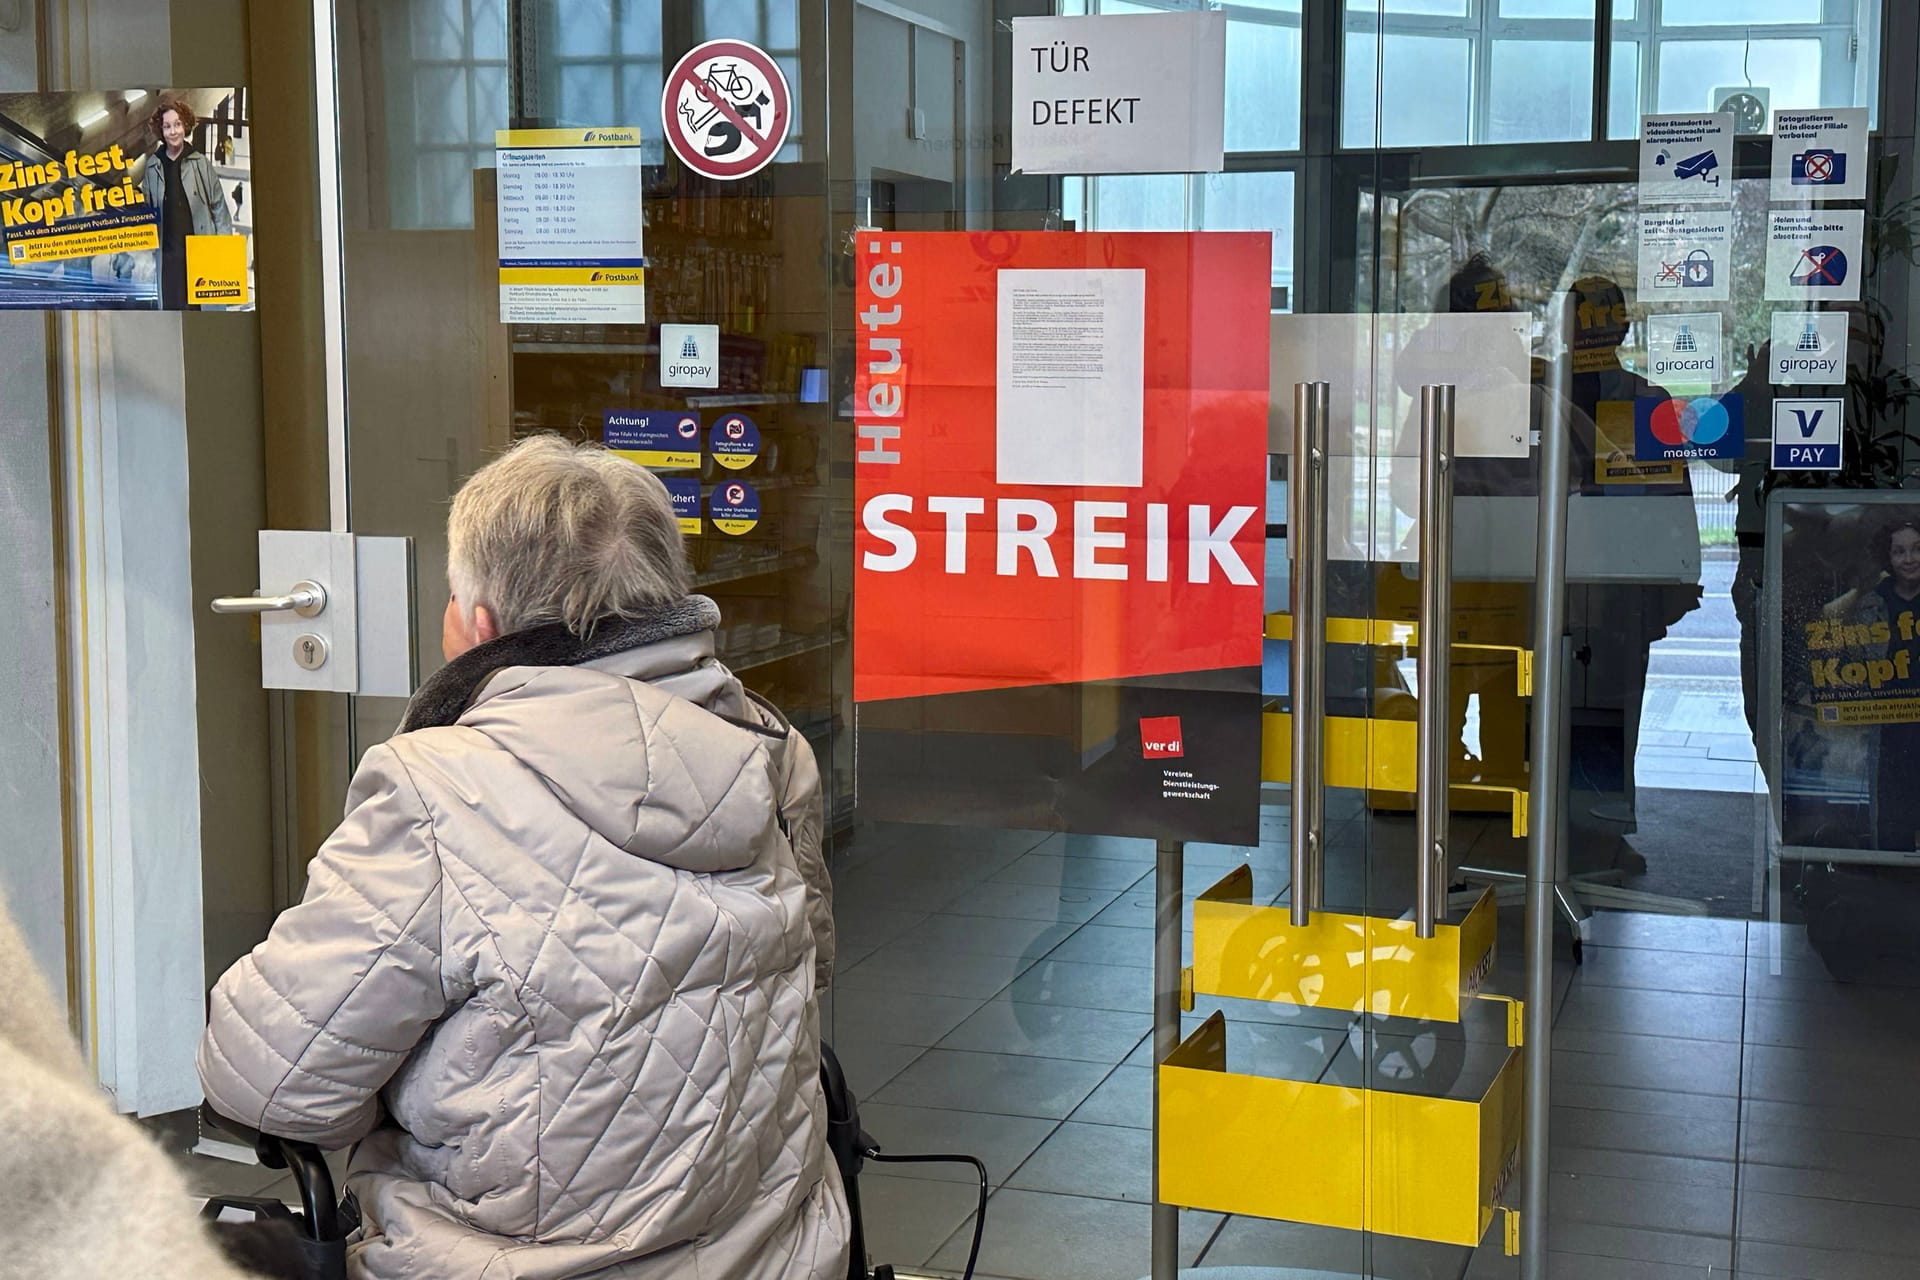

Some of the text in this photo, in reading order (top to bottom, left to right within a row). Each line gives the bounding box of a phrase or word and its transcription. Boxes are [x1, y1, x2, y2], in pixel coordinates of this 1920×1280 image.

[1031, 41, 1090, 73] TÜR
[1033, 98, 1141, 125] DEFEKT
[1646, 120, 1669, 128] Dieser
[1670, 119, 1702, 127] Standort
[1778, 115, 1834, 124] Fotografieren
[1646, 127, 1705, 136] videoüberwacht
[1778, 123, 1789, 131] ist
[1799, 122, 1823, 130] dieser
[1824, 122, 1848, 130] Filiale
[598, 133, 634, 142] Postbank
[1646, 135, 1703, 145] alarmgesichert!
[1778, 131, 1817, 140] verboten!
[0, 144, 135, 192] Zins fest.
[2, 177, 145, 227] Kopf frei.
[1644, 217, 1685, 228] Bargeld ist
[1773, 216, 1812, 224] Helm und
[1773, 224, 1844, 232] Sturmhaube bitte
[1773, 232, 1812, 240] absetzen!
[605, 272, 639, 282] Postbank
[858, 240, 903, 465] Heute:
[668, 362, 712, 378] giropay
[1655, 356, 1714, 374] girocard
[1779, 356, 1838, 374] giropay
[608, 416, 649, 428] Achtung!
[1788, 409, 1824, 438] V
[1663, 447, 1717, 458] maestro
[1790, 448, 1825, 463] PAY
[862, 492, 1261, 587] STREIK
[1805, 617, 1891, 650] Zins
[1811, 649, 1909, 689] Kopf
[1163, 770, 1193, 778] Vereinte
[1163, 780, 1220, 791] Dienstleistungs-
[1162, 790, 1211, 800] gewerkschaft
